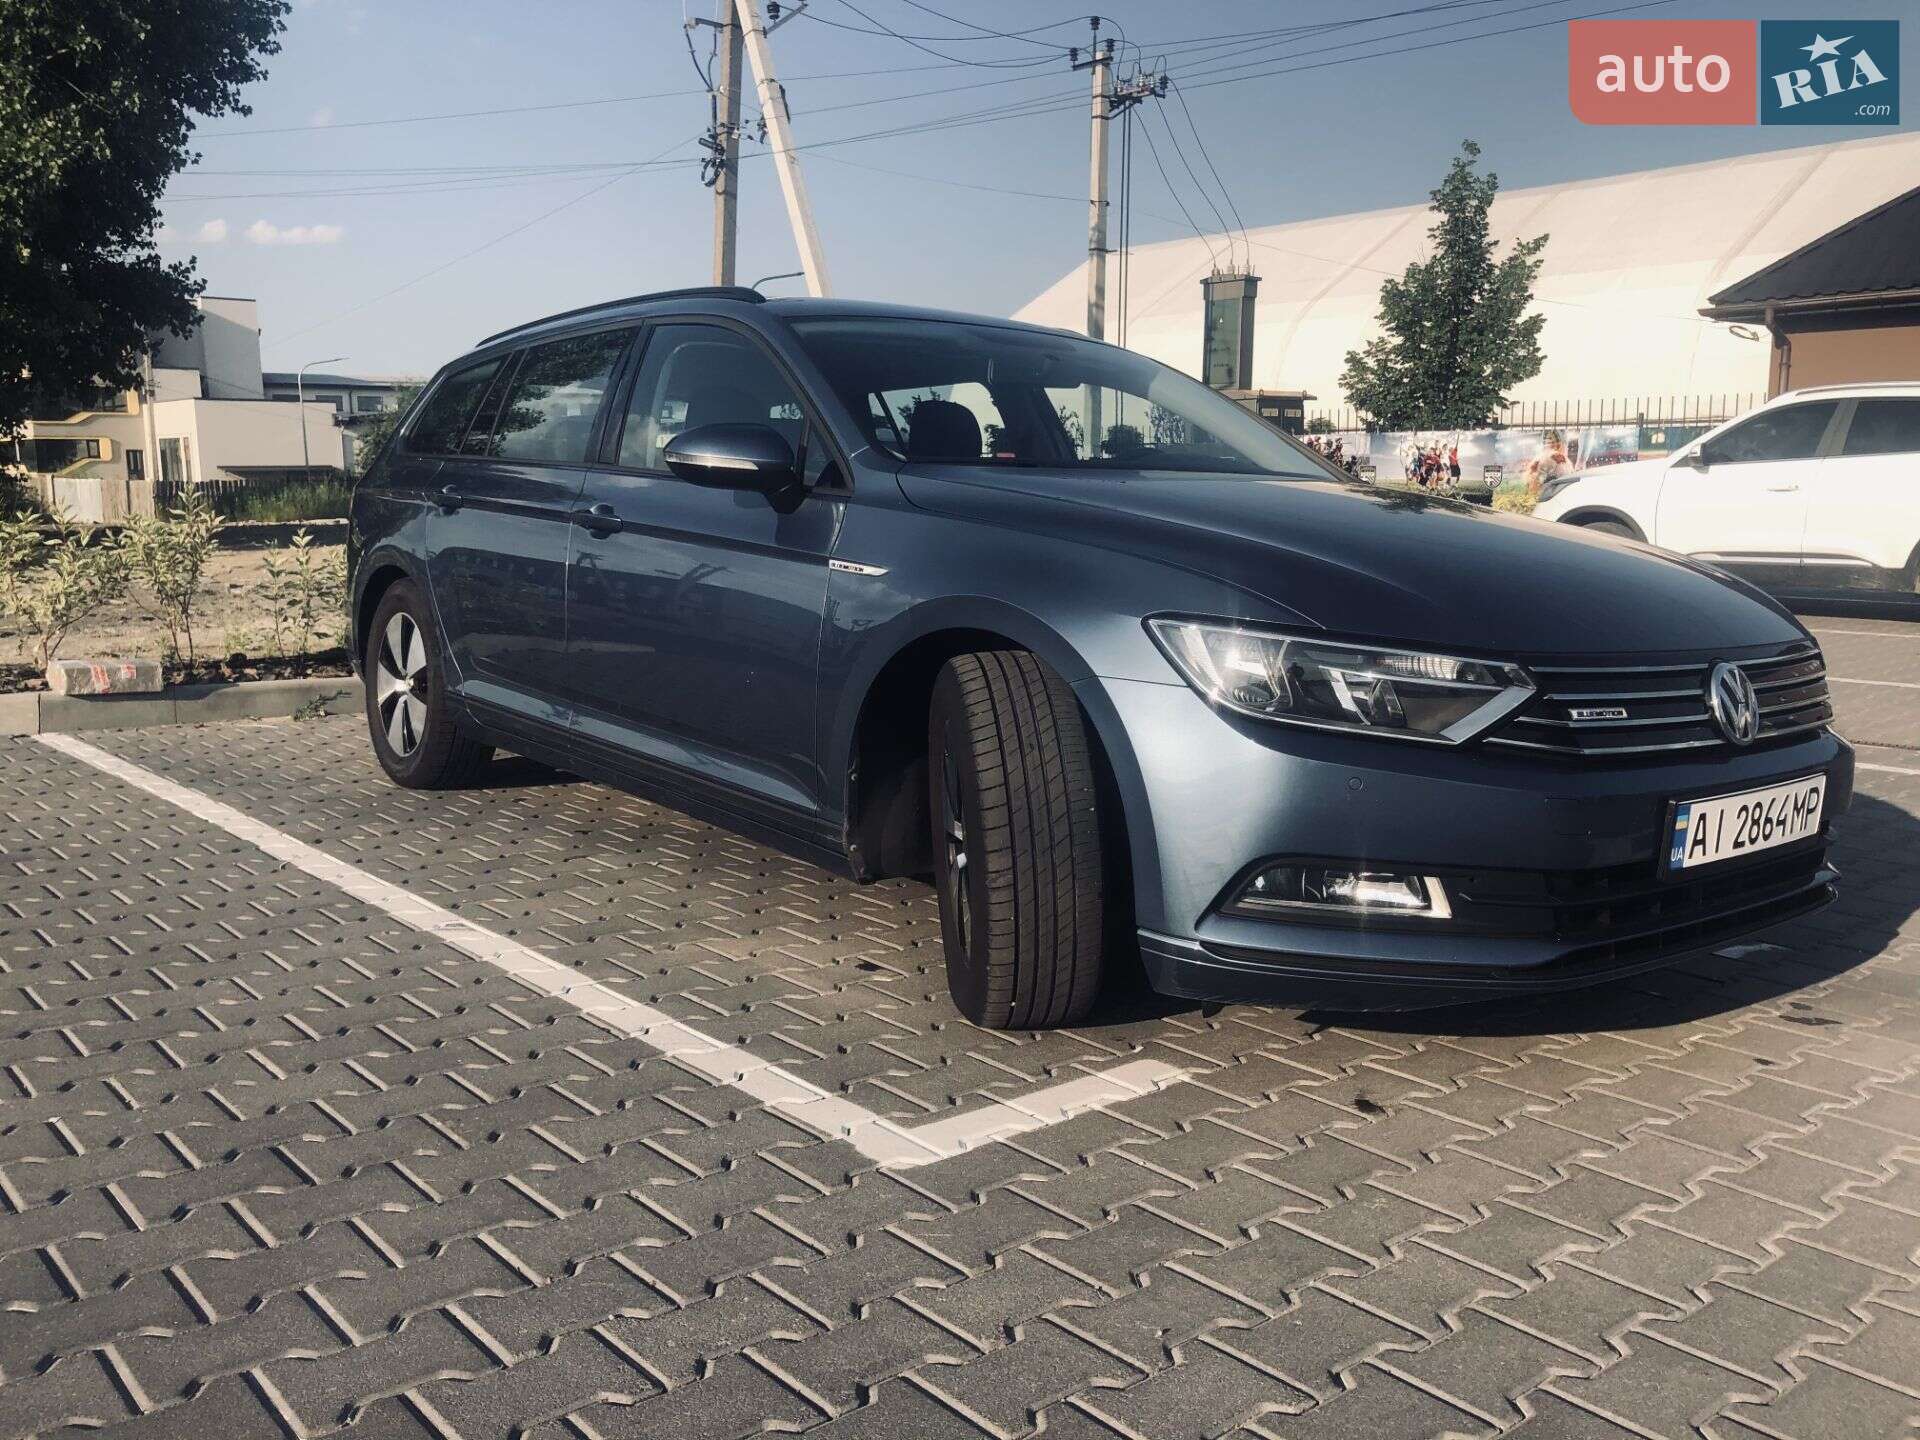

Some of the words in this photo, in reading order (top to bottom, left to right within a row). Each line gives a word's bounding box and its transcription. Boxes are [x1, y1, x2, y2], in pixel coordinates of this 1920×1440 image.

[1688, 809, 1724, 860] AI
[1732, 794, 1789, 851] 2864
[1790, 786, 1820, 835] MP
[1670, 848, 1683, 863] UA
